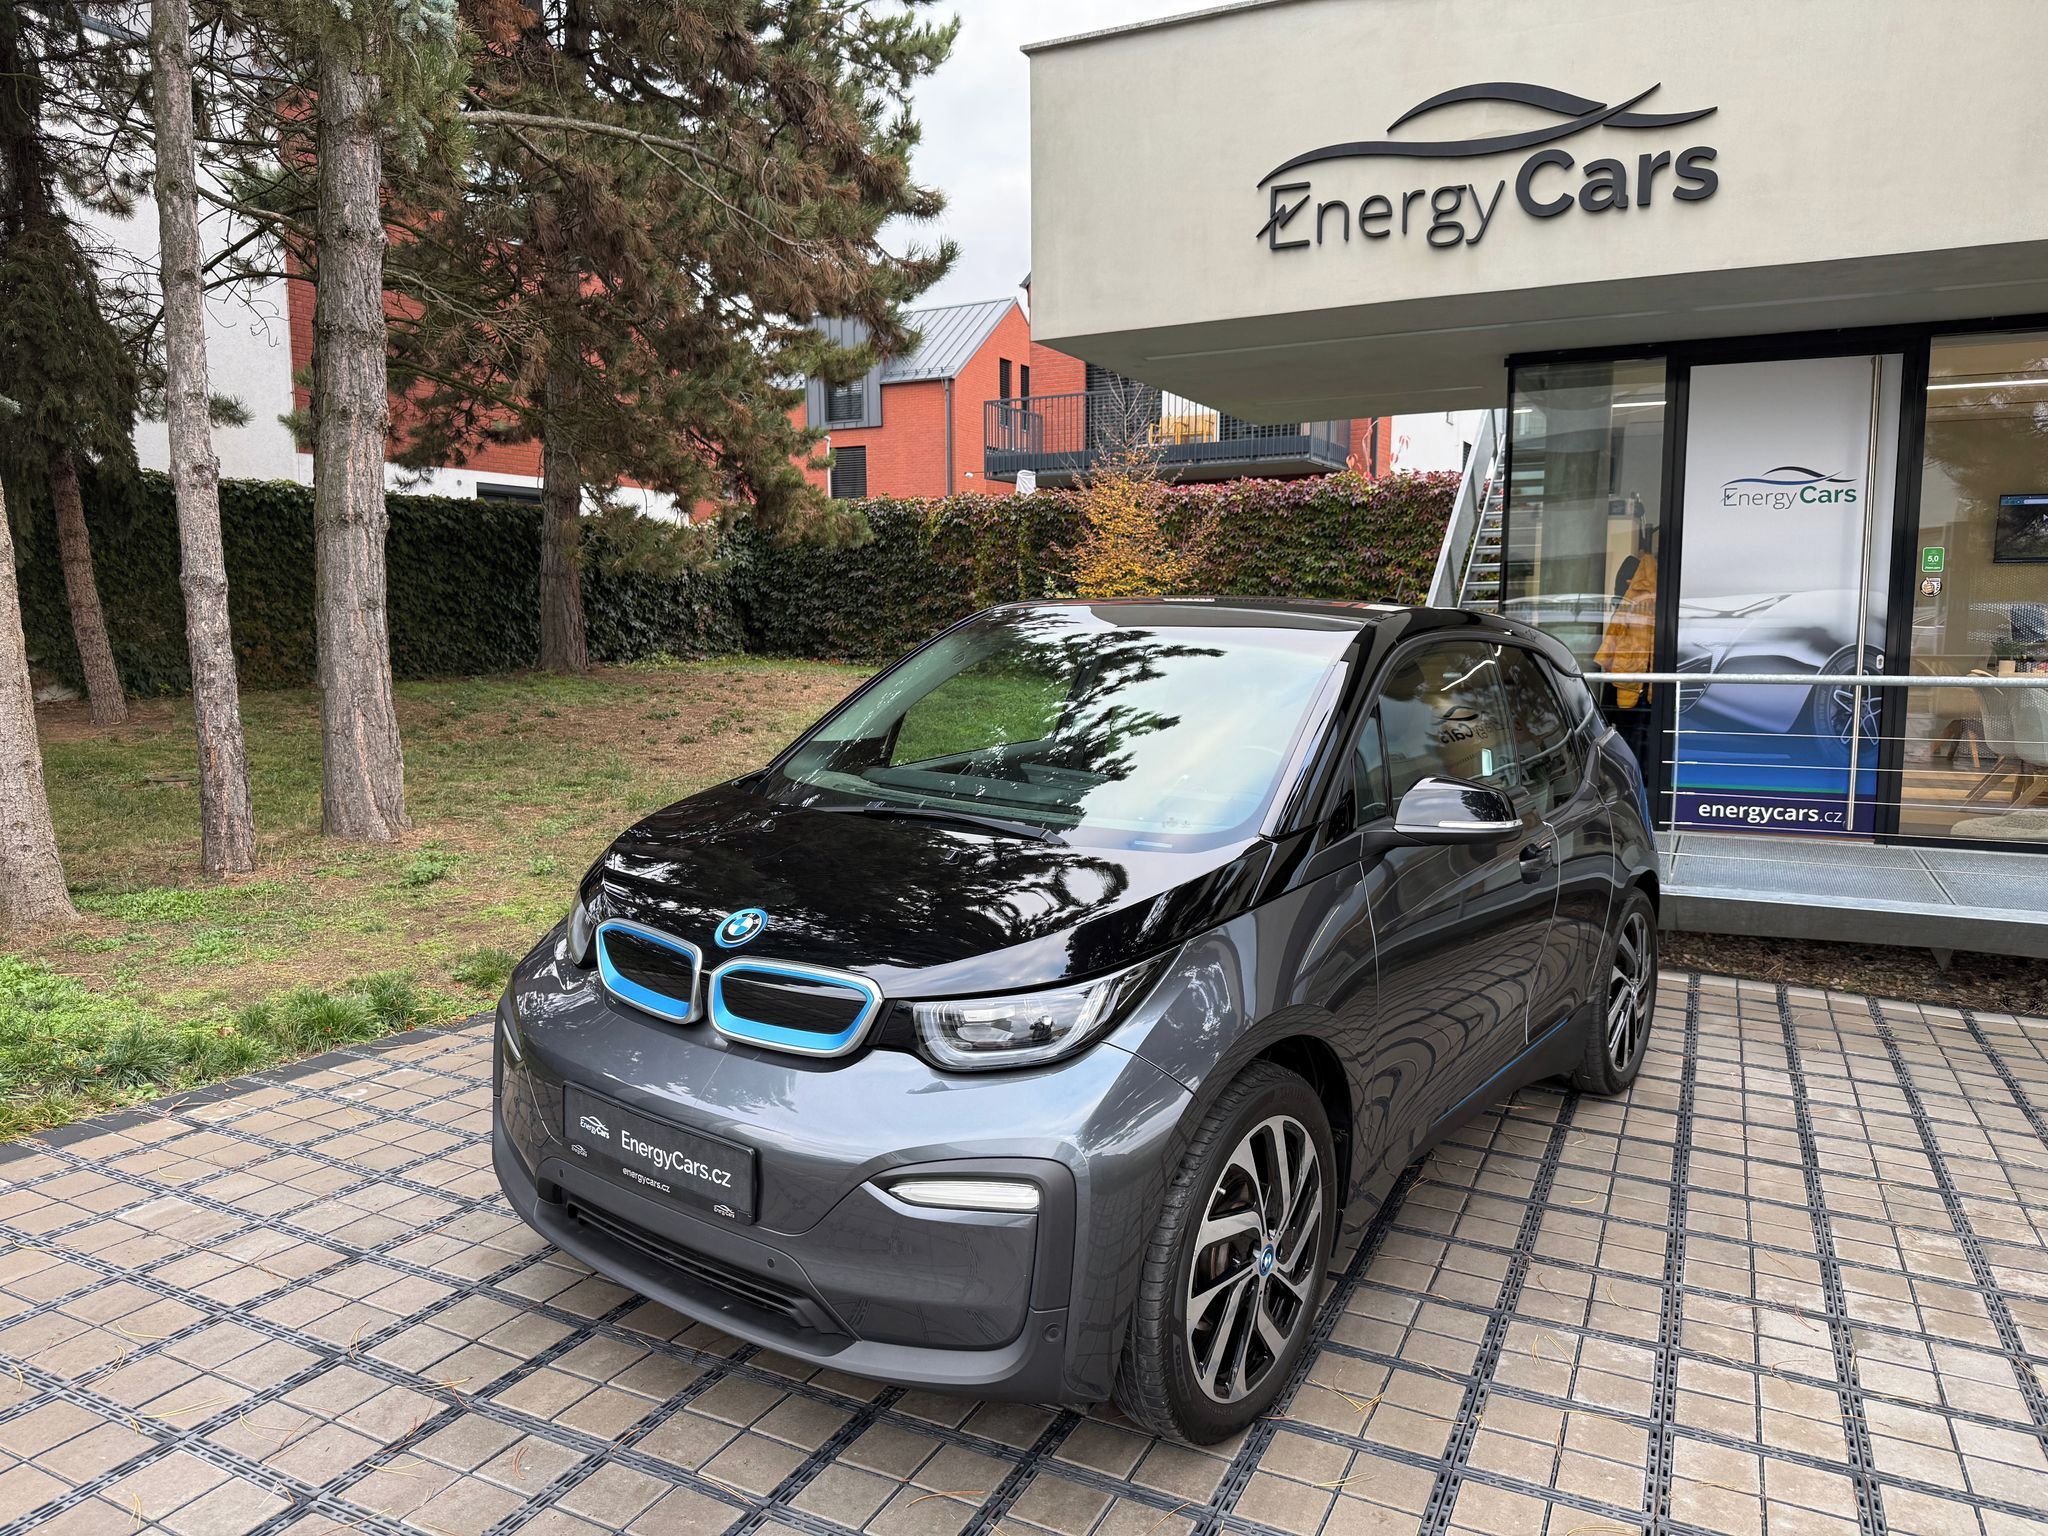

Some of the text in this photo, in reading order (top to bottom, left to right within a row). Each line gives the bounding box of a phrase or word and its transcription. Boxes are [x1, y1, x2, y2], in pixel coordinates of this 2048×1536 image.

[1257, 146, 1719, 250] EnergyCars
[1721, 486, 1857, 510] EnergyCars
[1699, 804, 1842, 824] energycars.cz
[621, 1130, 732, 1188] EnergyCars.cz
[622, 1167, 671, 1193] energycars.cz
